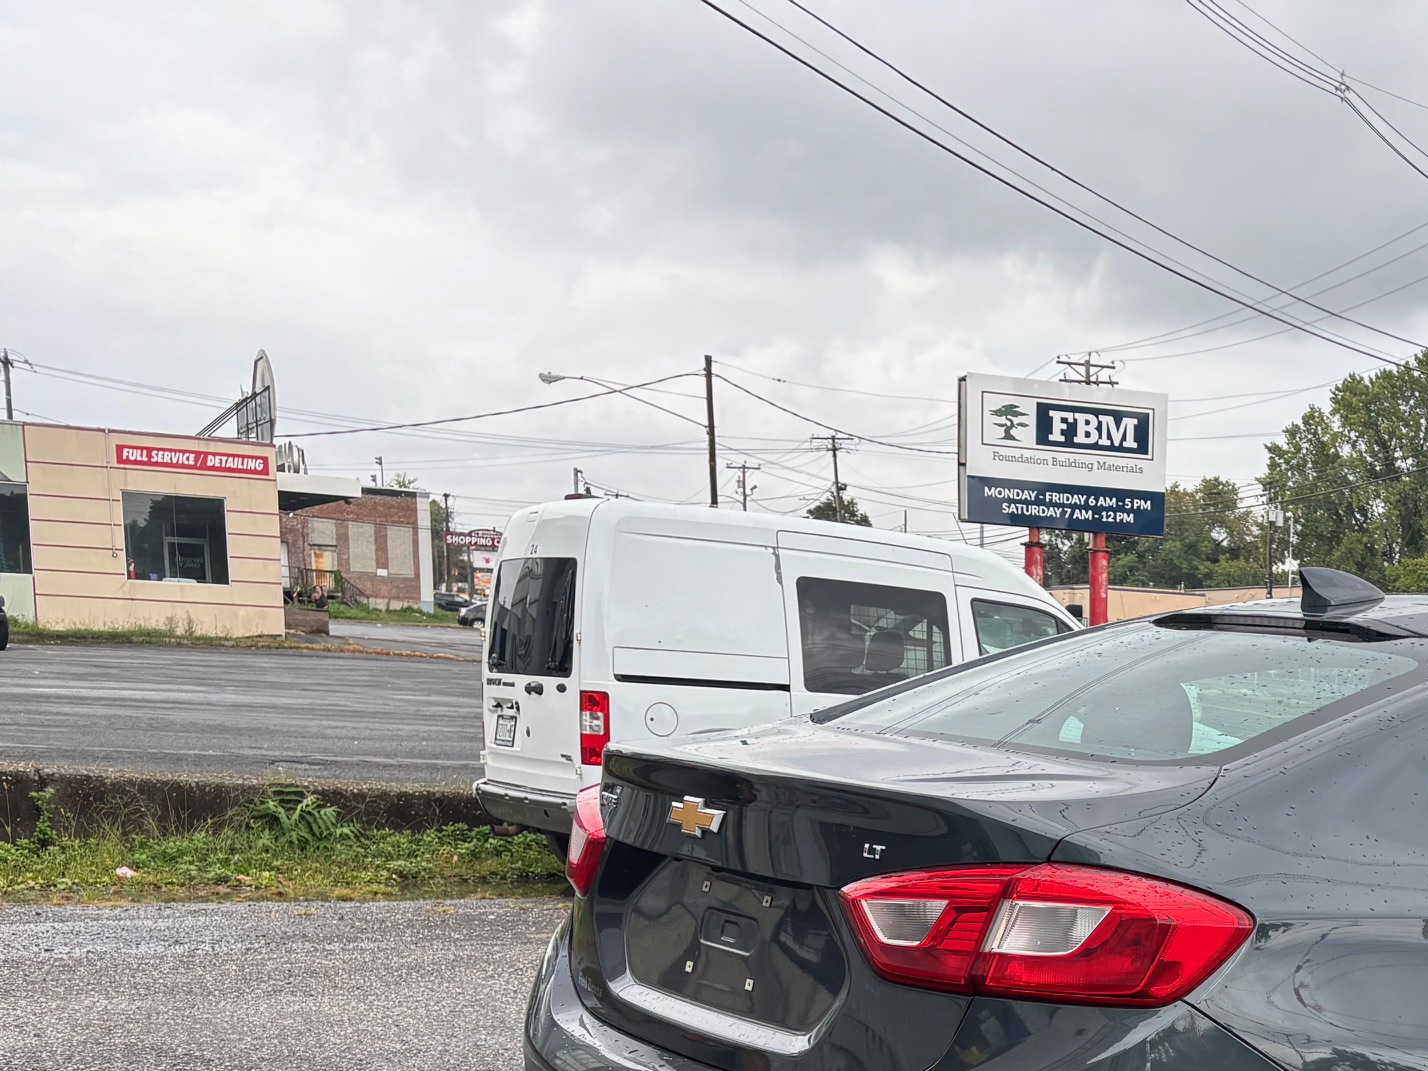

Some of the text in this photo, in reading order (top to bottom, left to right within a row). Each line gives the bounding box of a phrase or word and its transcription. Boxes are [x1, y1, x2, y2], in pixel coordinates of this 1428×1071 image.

[1048, 409, 1138, 449] FBM
[122, 448, 148, 462] FULL
[151, 450, 195, 466] SERVICE
[206, 455, 264, 471] DETAILING
[992, 451, 1144, 474] Foundation Building Materials
[984, 486, 1037, 501] MONDAY
[1045, 492, 1087, 506] FRIDAY
[1088, 495, 1095, 506] 6
[1097, 496, 1117, 508] AM
[1124, 498, 1132, 509] 5
[1133, 499, 1151, 511] PM
[1001, 502, 1063, 518] SATURDAY
[1064, 508, 1071, 519] 7
[1072, 509, 1092, 521] AM
[1101, 510, 1114, 523] 12
[1116, 511, 1134, 524] PM
[446, 534, 492, 546] SHOPPING
[530, 544, 539, 555] 24
[863, 843, 886, 859] LT
